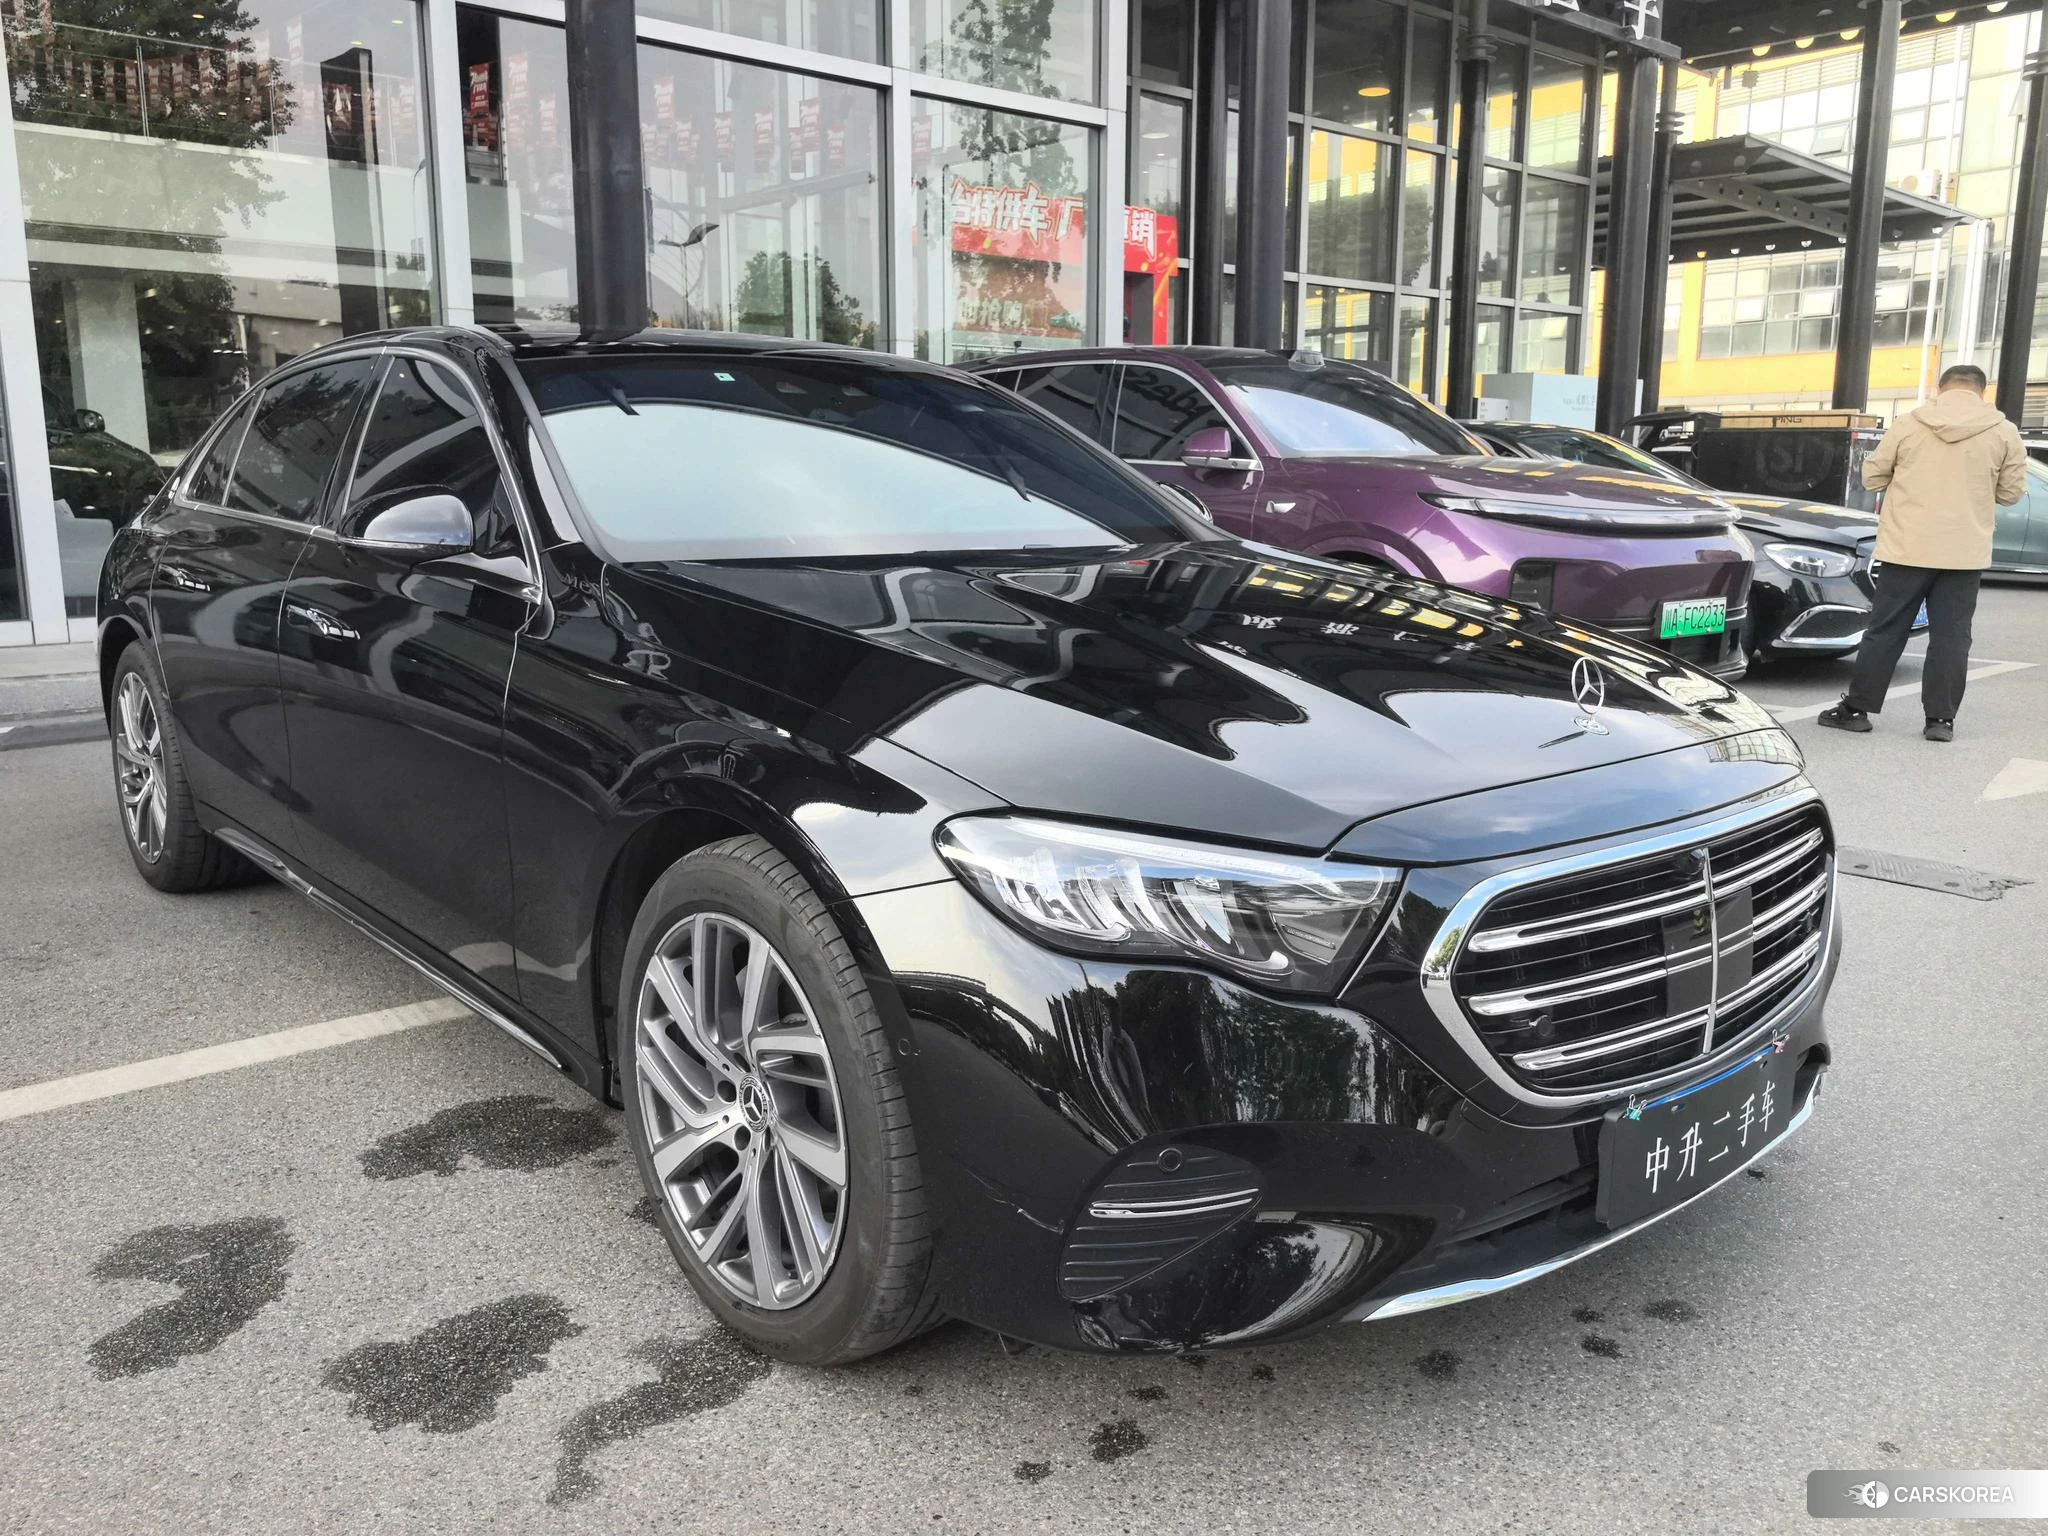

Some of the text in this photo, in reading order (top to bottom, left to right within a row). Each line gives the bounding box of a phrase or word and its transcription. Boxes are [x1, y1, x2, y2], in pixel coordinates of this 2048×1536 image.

[1645, 1080, 1776, 1194] 中升二手车
